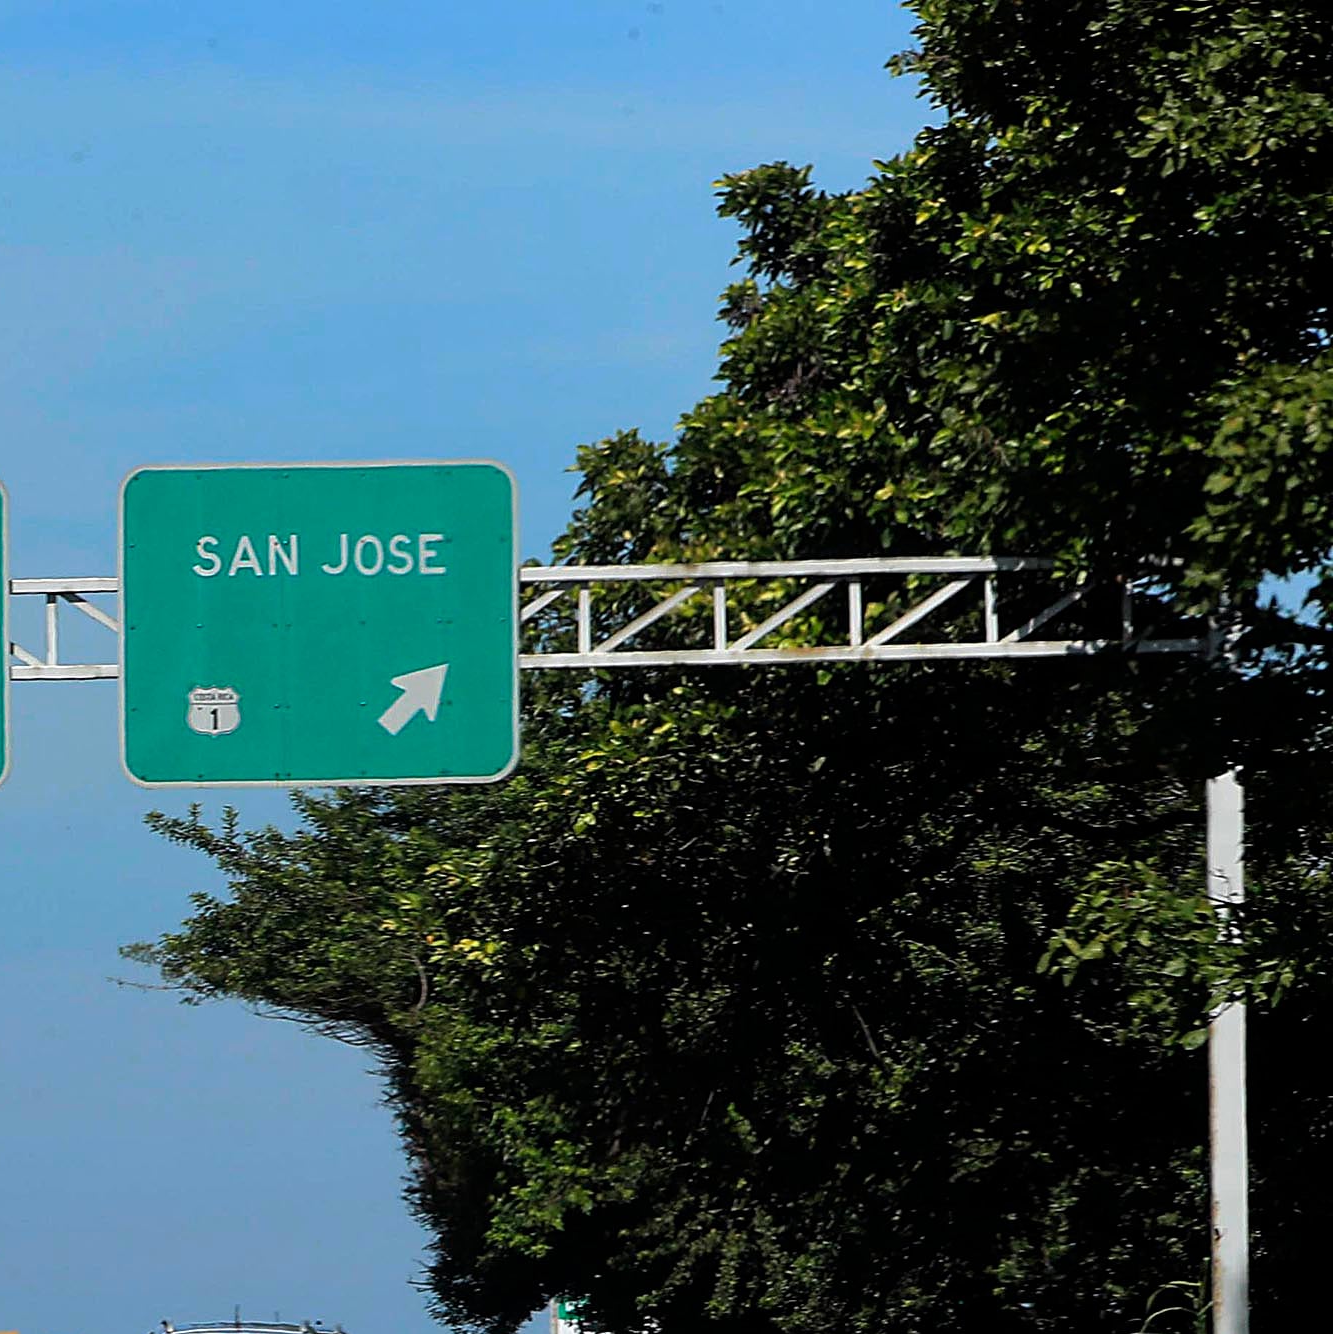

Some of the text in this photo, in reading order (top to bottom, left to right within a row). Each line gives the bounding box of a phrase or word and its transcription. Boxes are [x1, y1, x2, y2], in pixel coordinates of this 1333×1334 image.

[192, 533, 447, 577] SAN JOSE
[210, 708, 219, 730] 1
